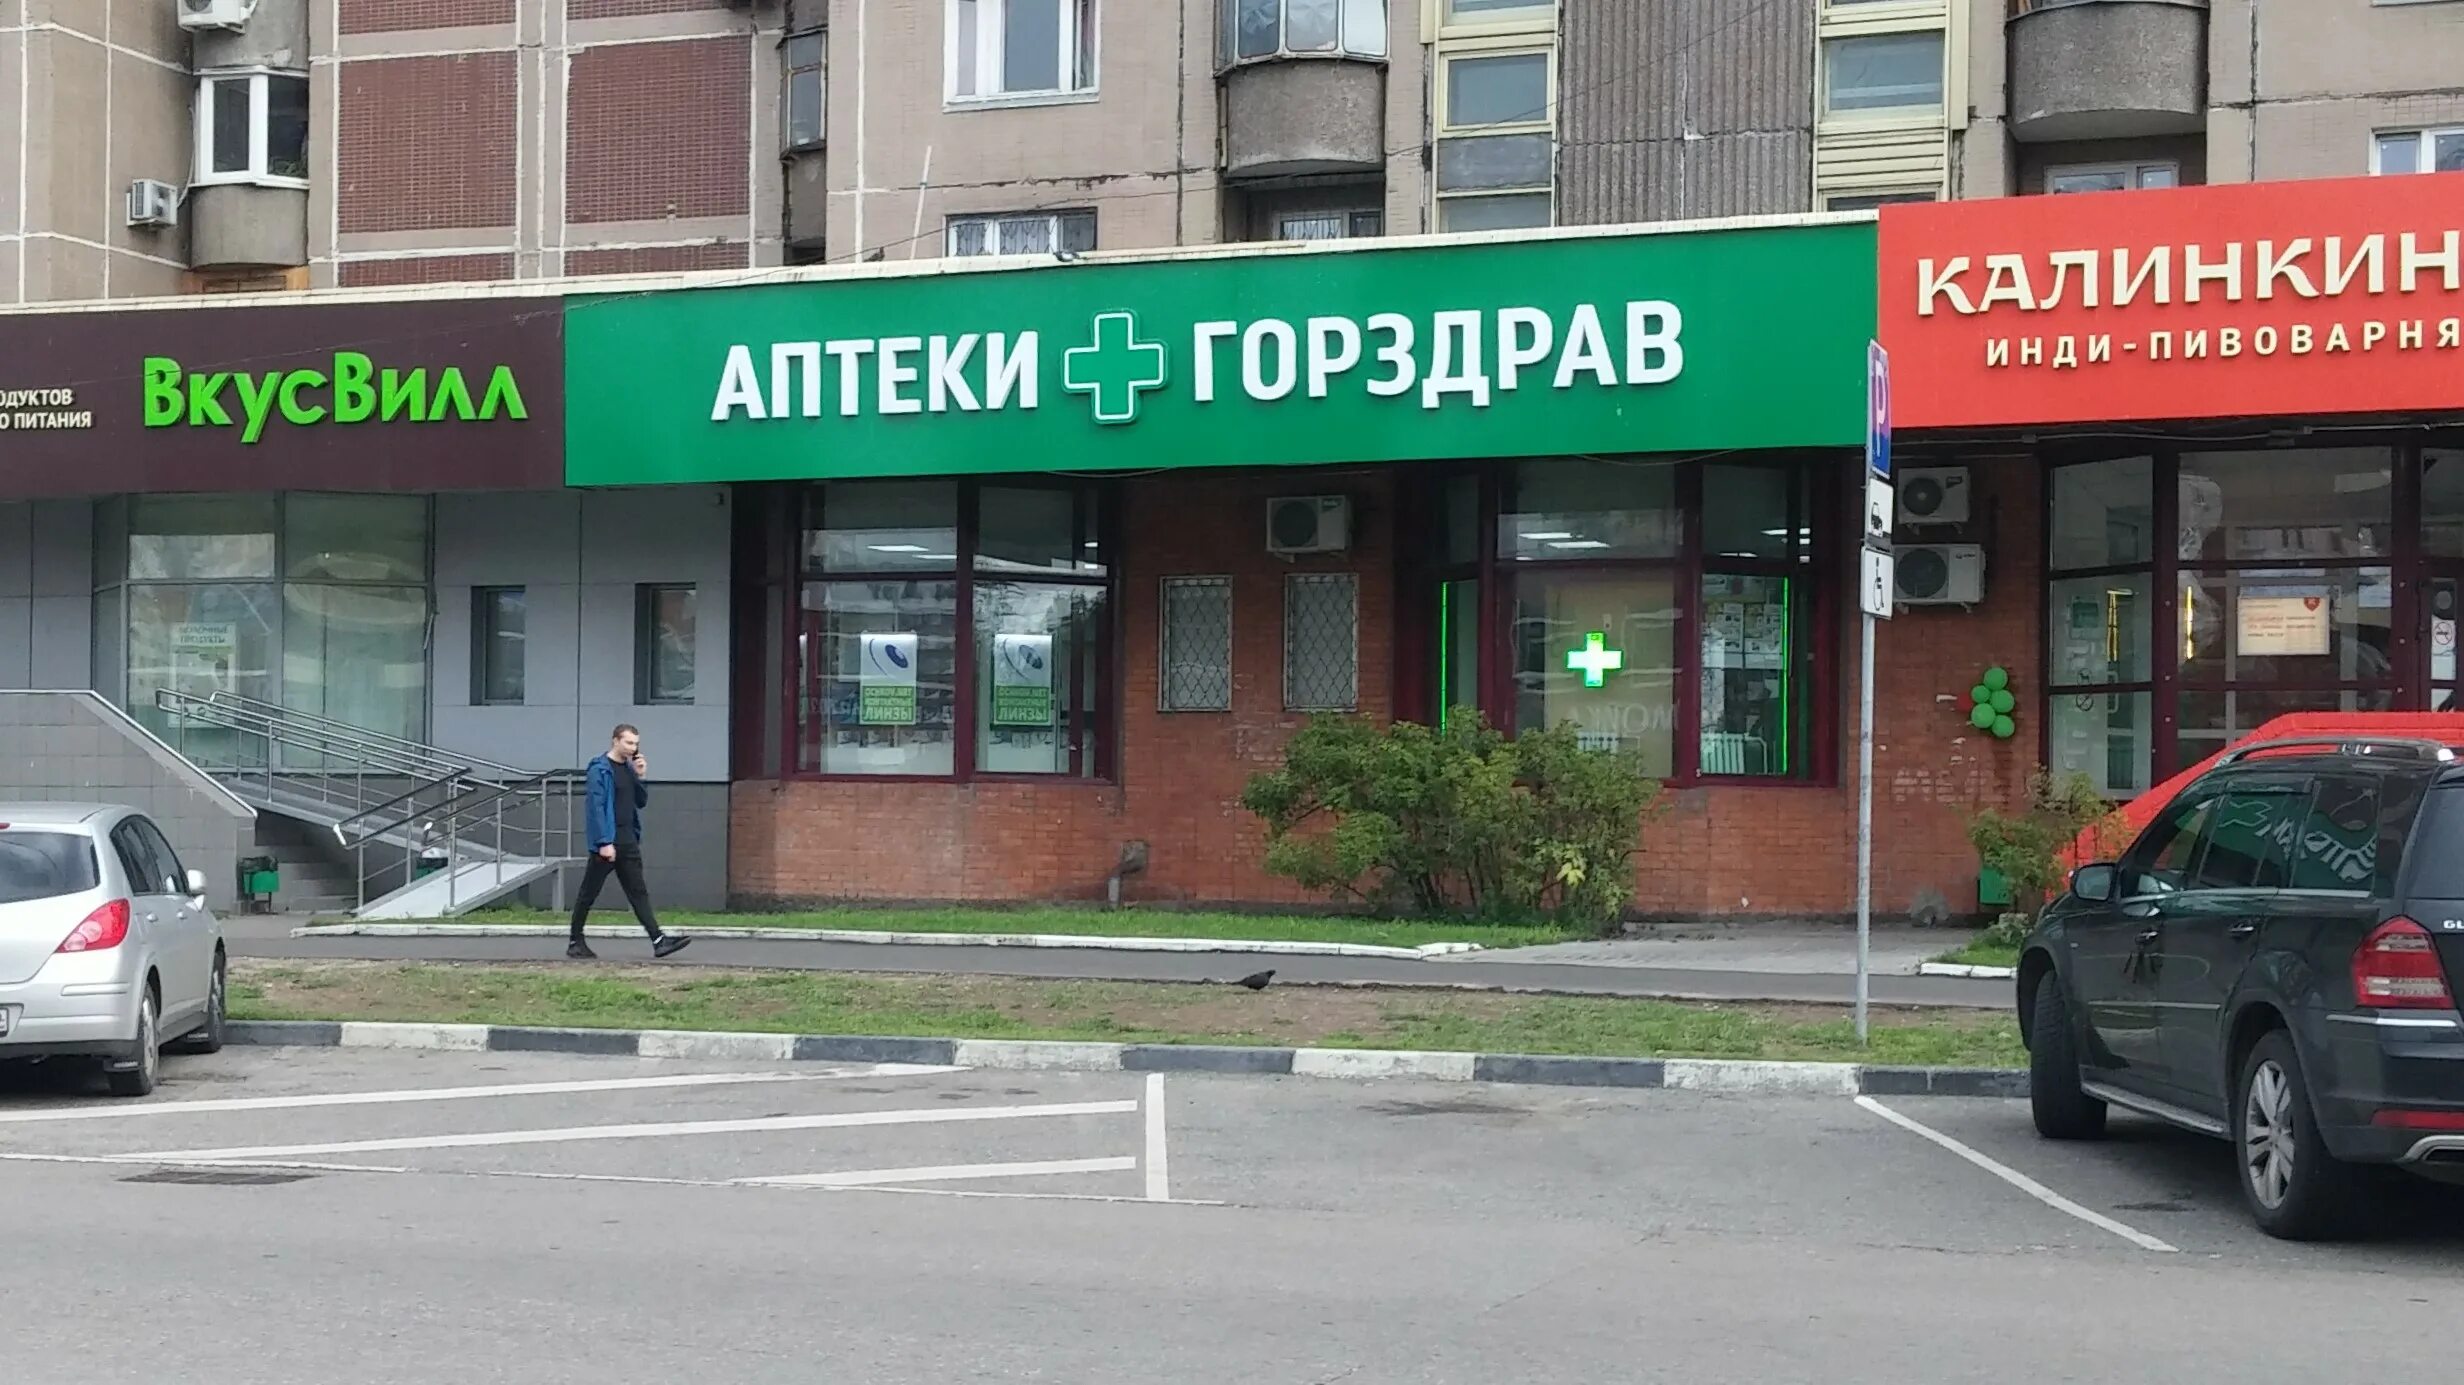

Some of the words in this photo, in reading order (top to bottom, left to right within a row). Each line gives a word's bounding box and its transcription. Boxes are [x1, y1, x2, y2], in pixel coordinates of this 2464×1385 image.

[1917, 229, 2461, 316] КАЛИНКИН
[1986, 317, 2461, 368] ИНДИ-ПИВОВАРНЯ
[711, 331, 1039, 423] АПТЕКИ
[1194, 299, 1684, 410] ГОРЗДРАВ
[14, 411, 92, 429] ПИТАНИЯ
[864, 706, 912, 720] ЛИНЗЫ
[998, 706, 1047, 720] ЛИНЗЫ
